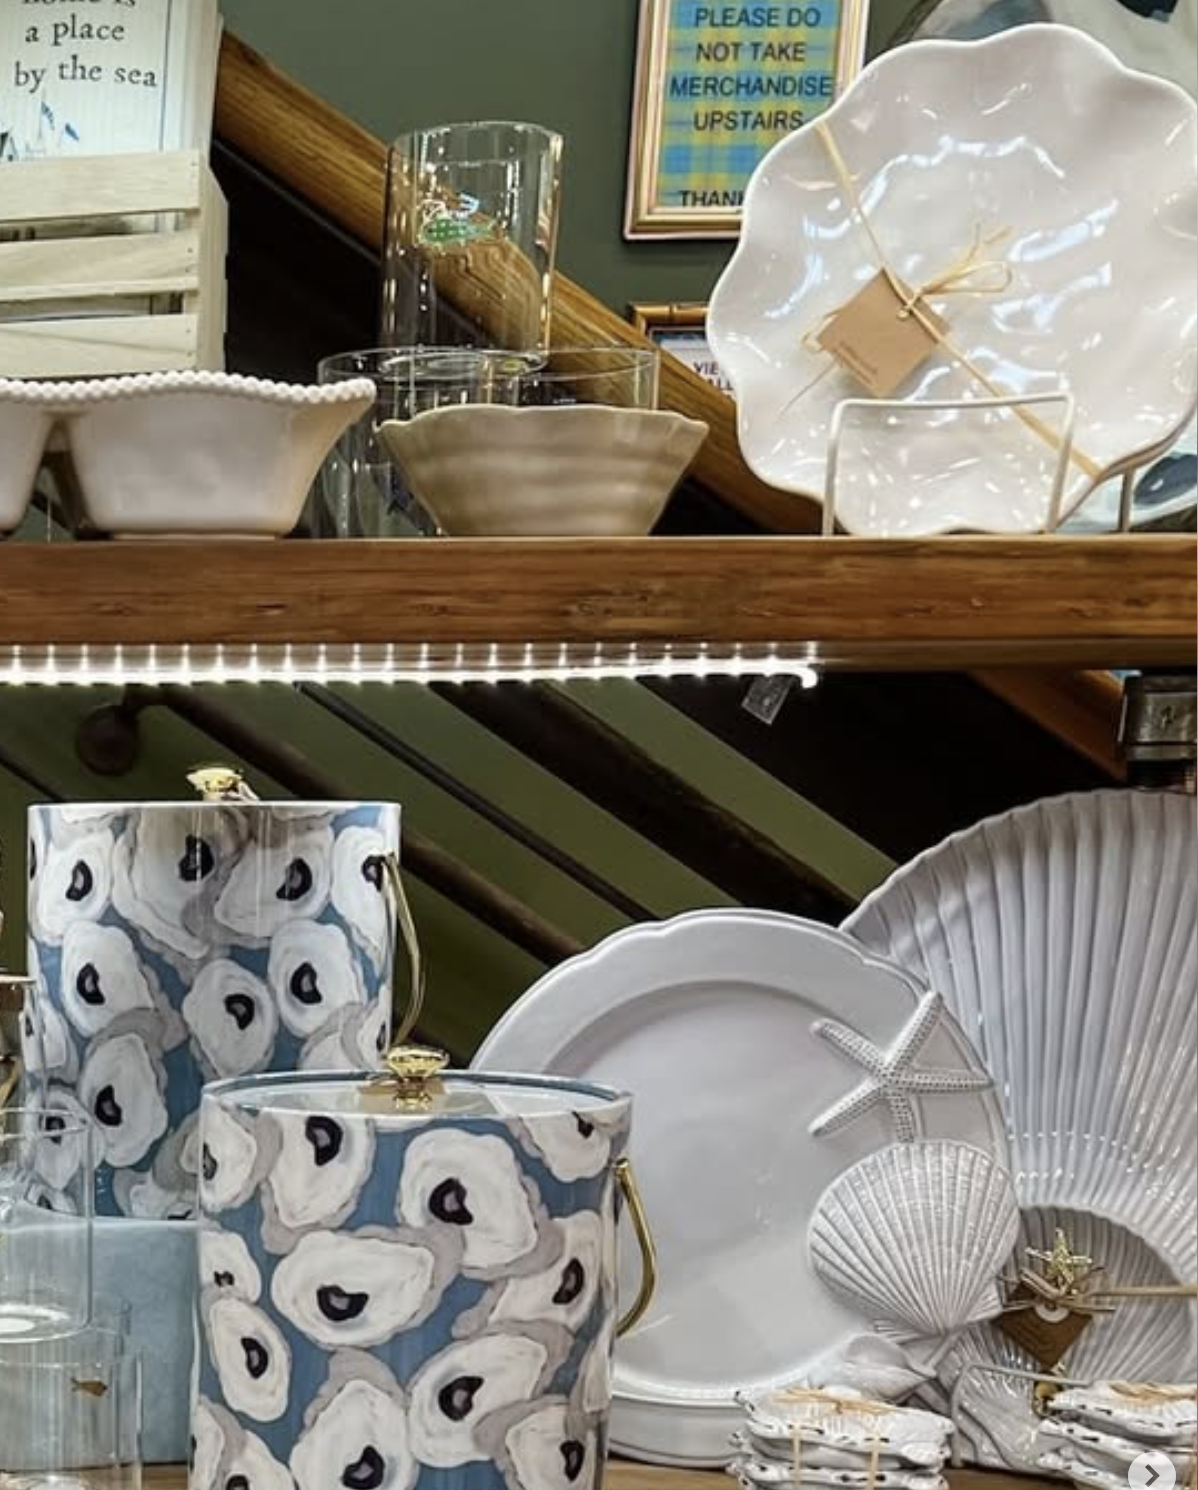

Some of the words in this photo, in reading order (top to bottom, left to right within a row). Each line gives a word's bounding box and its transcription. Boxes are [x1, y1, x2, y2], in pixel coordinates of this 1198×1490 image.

[694, 7, 780, 28] PLEASE
[787, 7, 821, 28] DO
[25, 26, 39, 43] a
[51, 12, 125, 46] place
[695, 42, 743, 62] NOT
[752, 42, 807, 62] TAKE
[14, 61, 46, 94] by
[58, 54, 102, 82] the
[114, 66, 157, 87] sea
[669, 76, 835, 97] MERCHANDISE
[693, 110, 805, 131] UPSTAIRS
